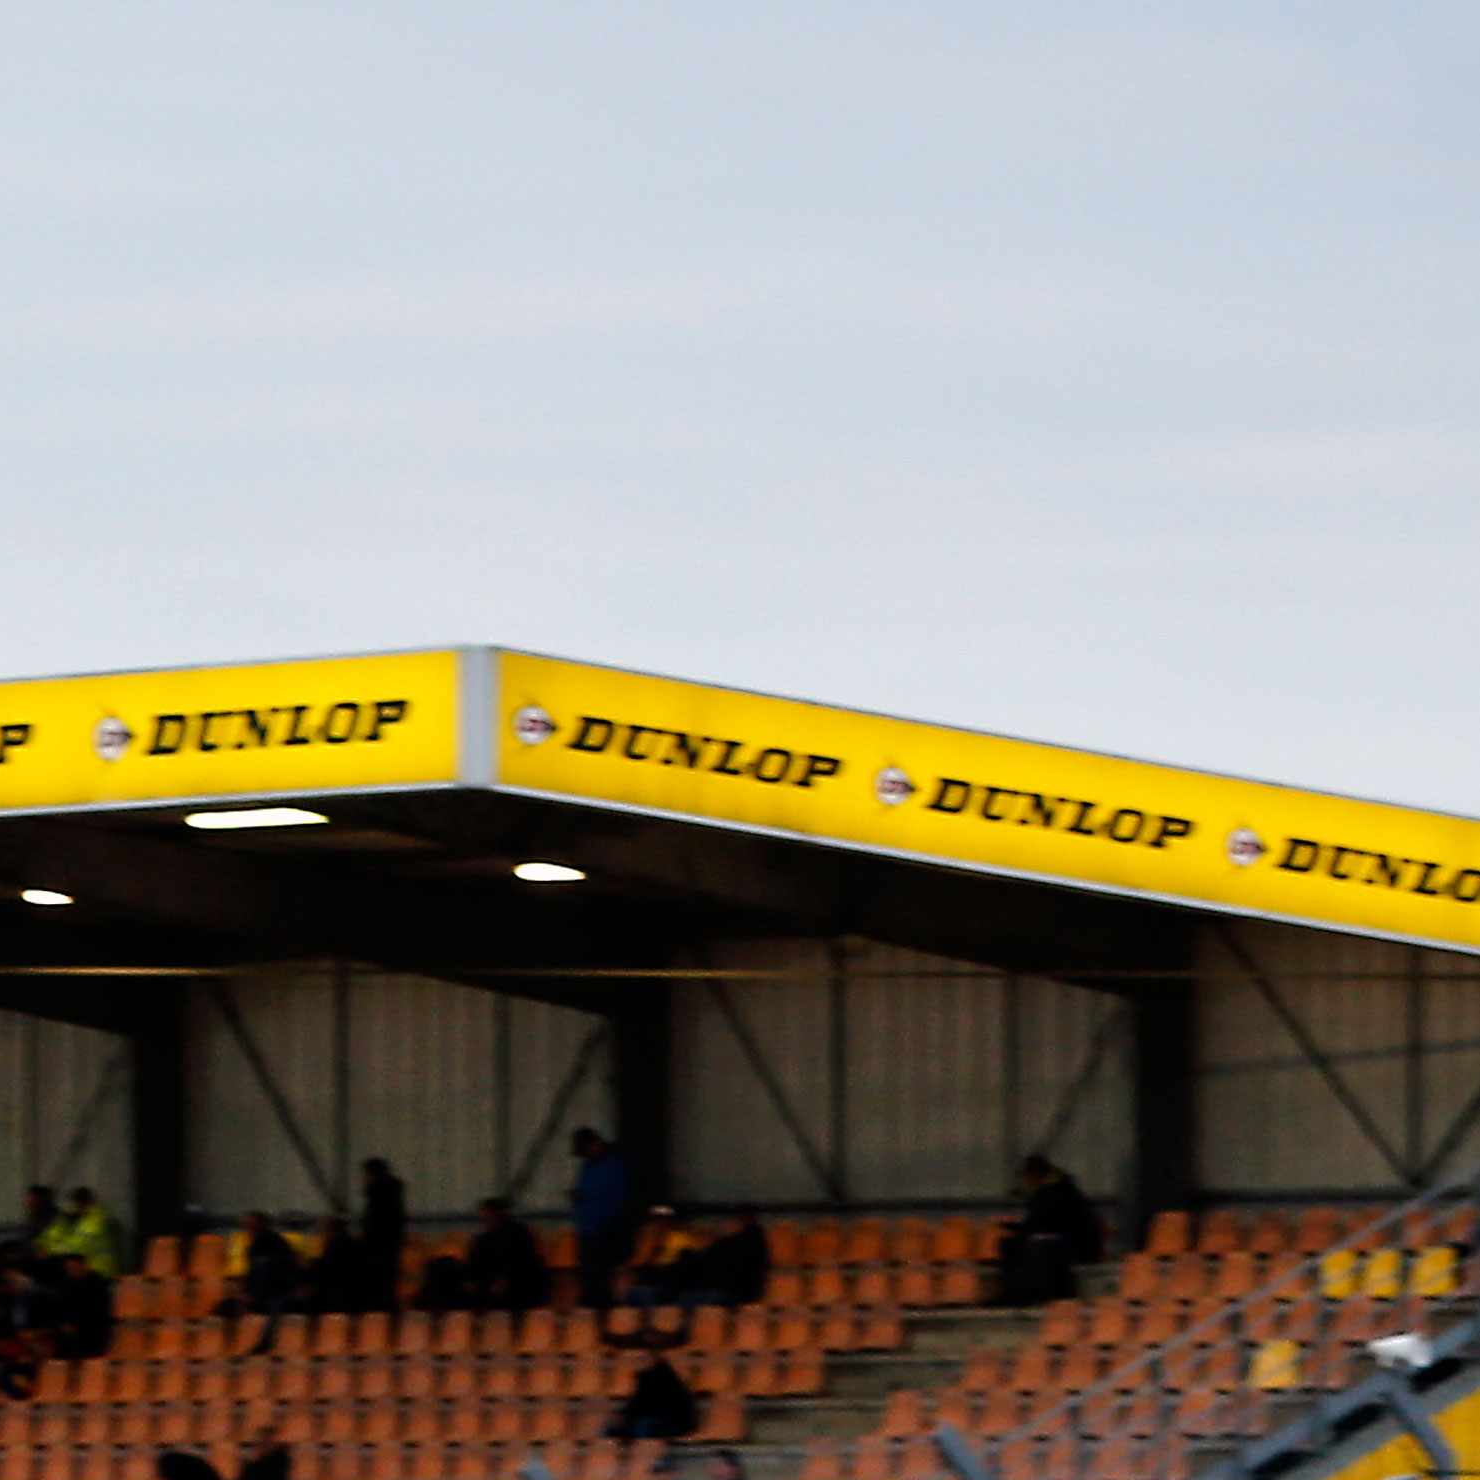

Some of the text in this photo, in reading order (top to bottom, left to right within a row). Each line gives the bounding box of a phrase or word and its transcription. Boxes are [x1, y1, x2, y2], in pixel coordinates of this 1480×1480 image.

[145, 700, 409, 756] DUNLOP
[564, 715, 842, 791] DUNLOP
[924, 776, 1195, 850] DUNLOP
